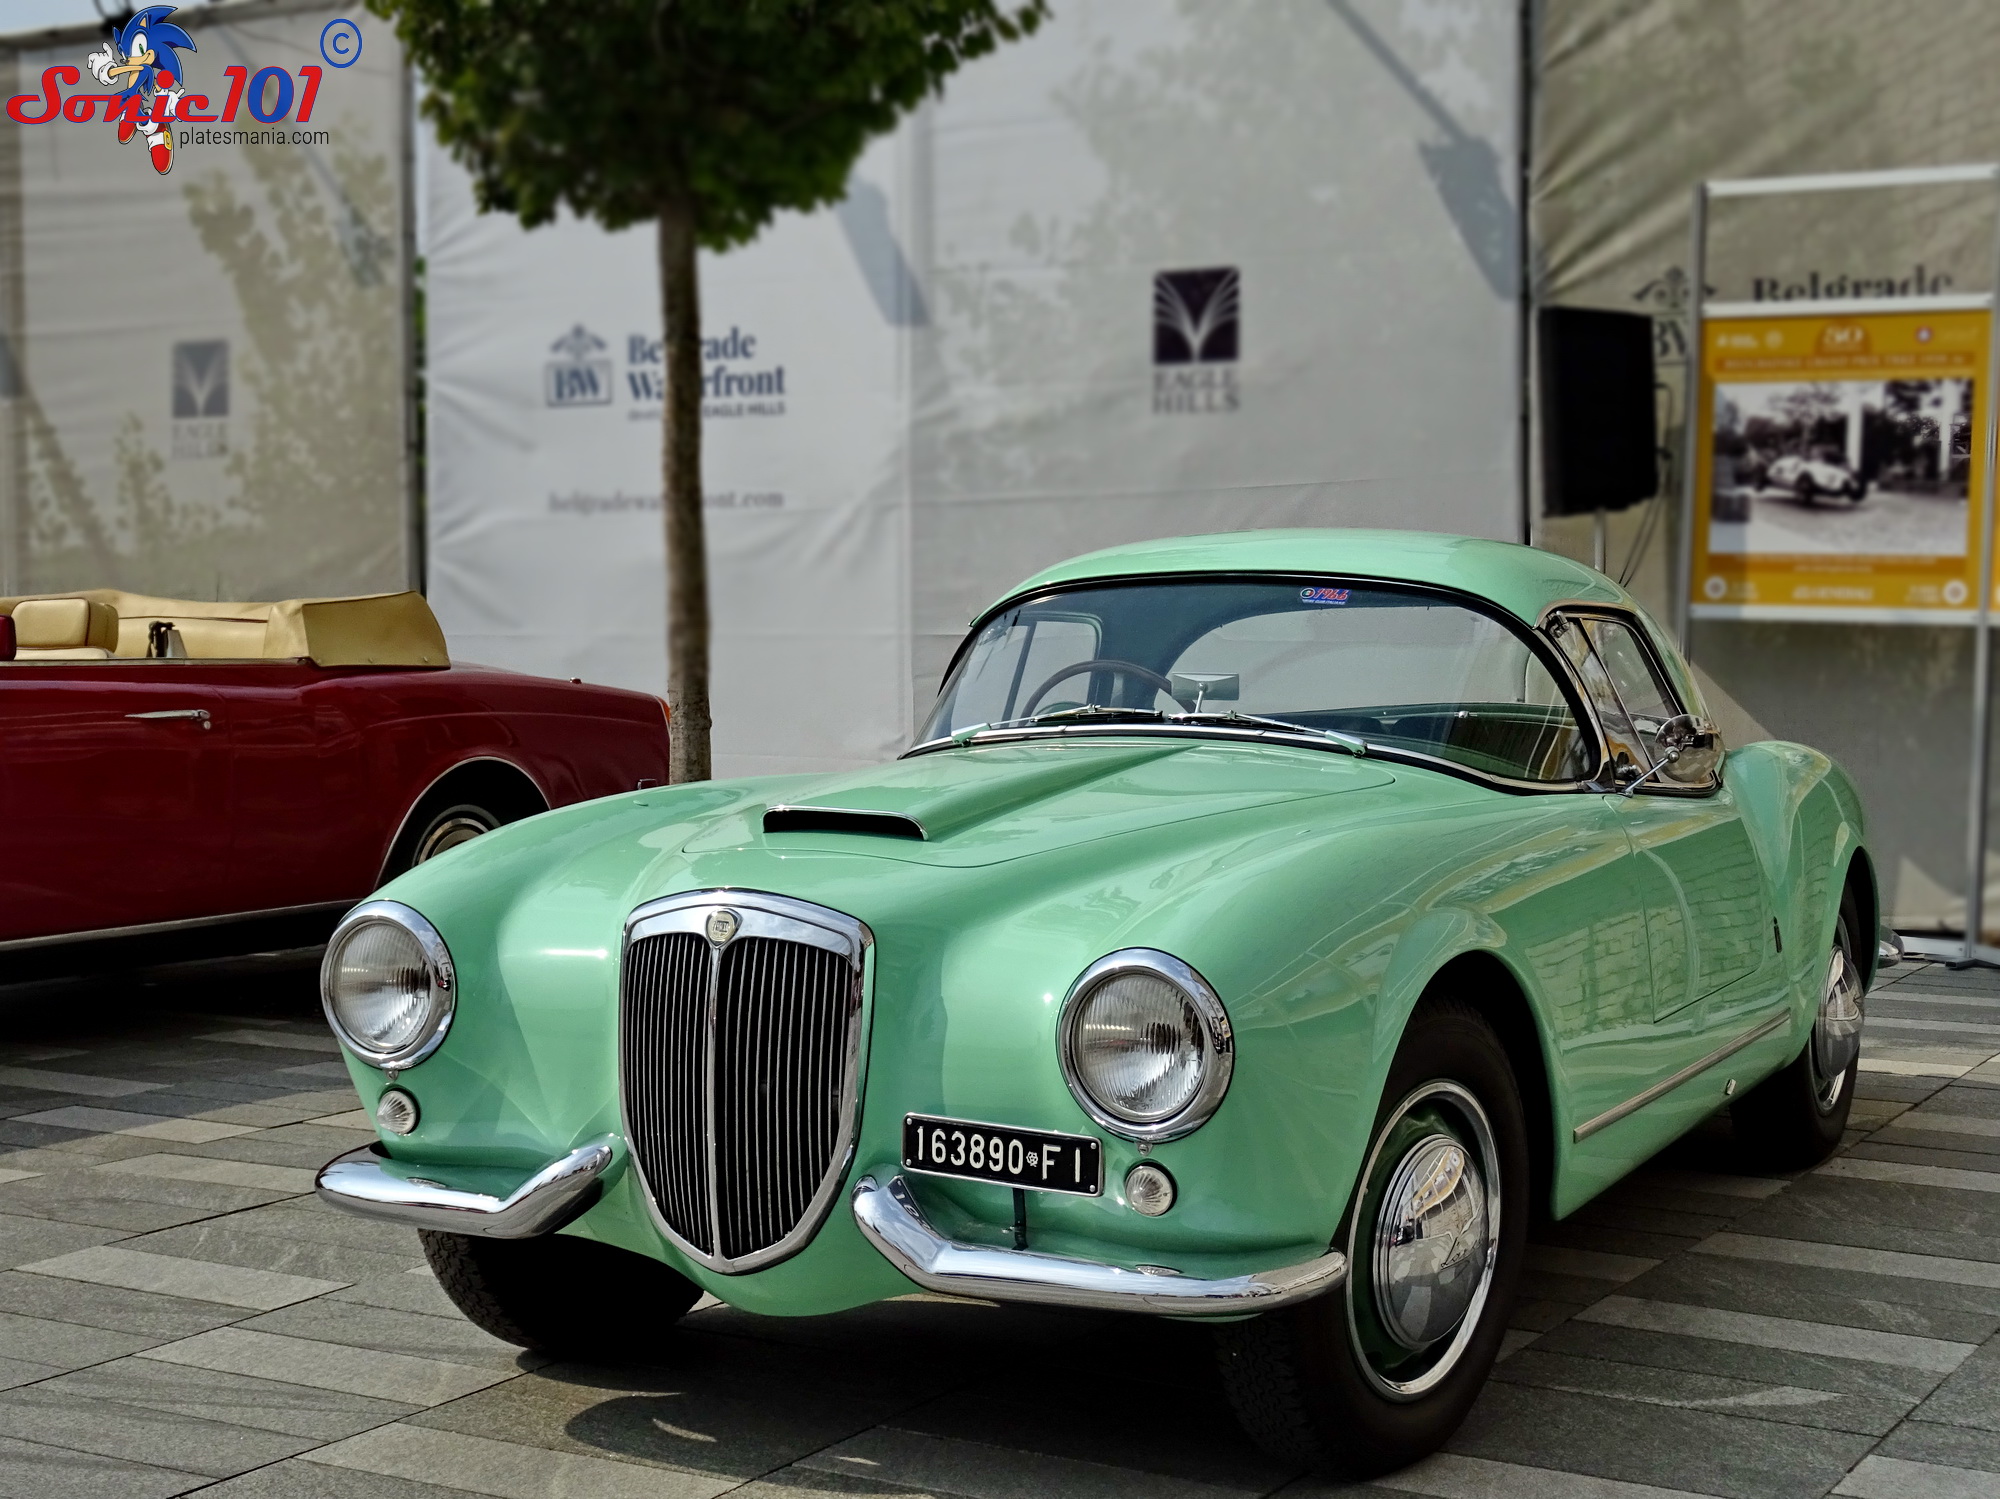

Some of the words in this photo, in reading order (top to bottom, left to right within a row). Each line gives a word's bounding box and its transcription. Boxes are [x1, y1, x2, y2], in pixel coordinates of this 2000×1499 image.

[627, 326, 756, 365] Beade
[627, 366, 785, 401] Warfront
[917, 1126, 1023, 1175] 163890
